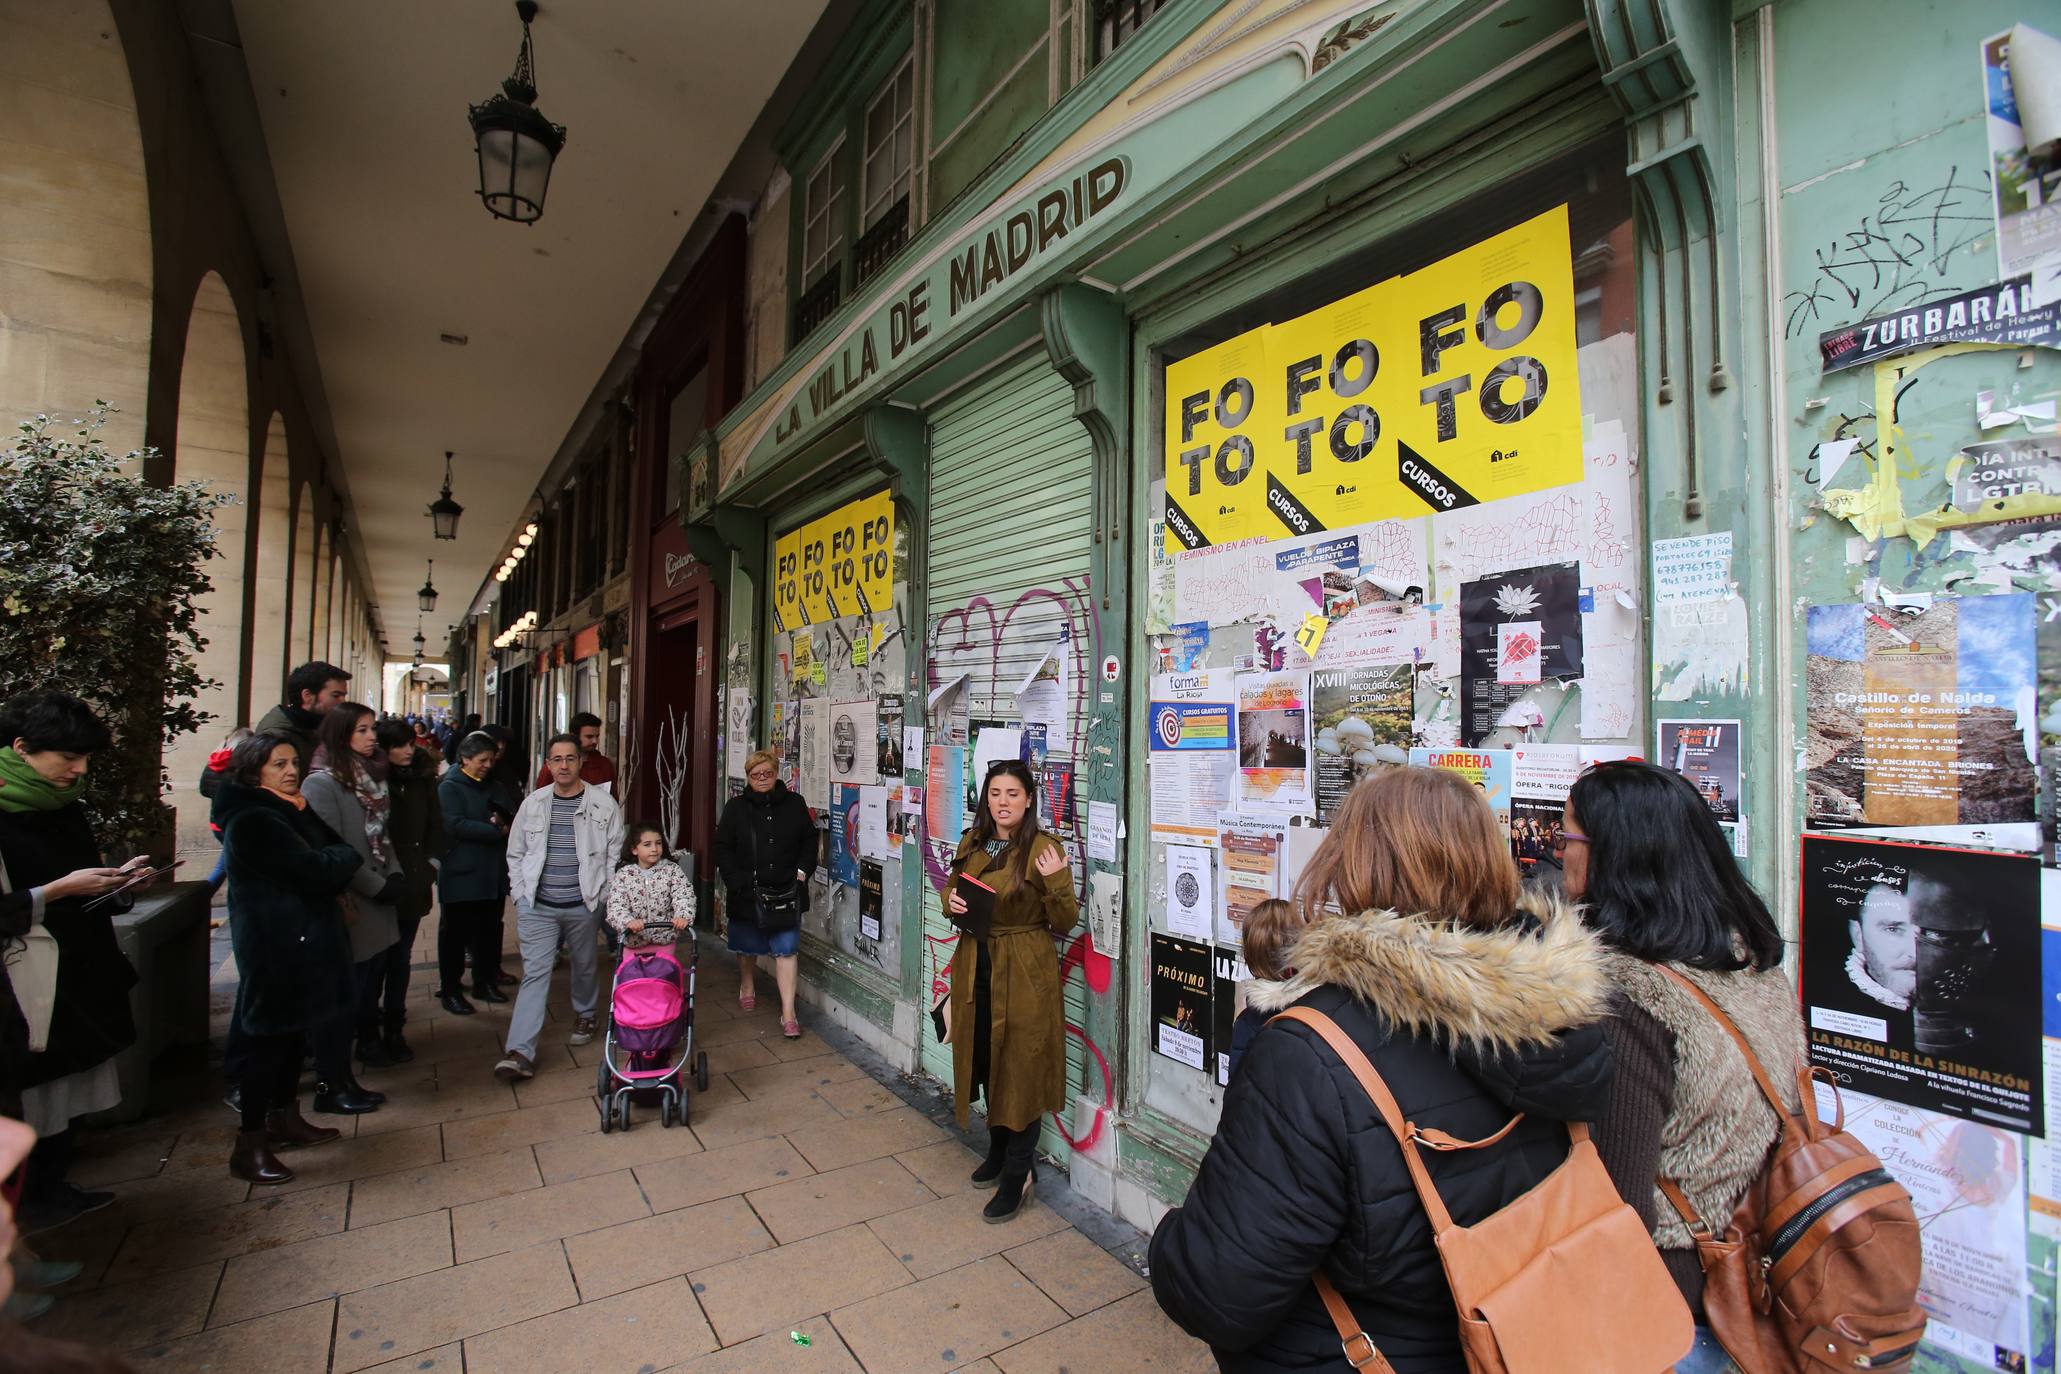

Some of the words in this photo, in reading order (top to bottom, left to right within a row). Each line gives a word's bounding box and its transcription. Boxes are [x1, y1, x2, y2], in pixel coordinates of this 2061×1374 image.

[776, 409, 801, 446] LA
[808, 330, 880, 416] VILLA
[889, 278, 932, 360] DE
[949, 154, 1133, 317] MADRID
[1420, 280, 1544, 377] FO
[1923, 326, 1979, 344] Festival
[1985, 320, 2002, 331] de
[2008, 311, 2053, 326] Heavy
[1829, 338, 1857, 358] LIBRE
[1286, 338, 1380, 416] FO
[1181, 376, 1254, 443] FO
[1420, 355, 1548, 443] TO
[1285, 403, 1381, 475] TO
[1180, 434, 1254, 496] TO
[1504, 450, 1518, 459] cdi
[1401, 460, 1457, 508] CURSOS
[1268, 487, 1310, 533] CURSOS
[863, 515, 889, 550] FO
[1166, 507, 1200, 547] CURSOS
[832, 526, 855, 559] FO
[1179, 544, 1224, 561] FEMINISMO
[1225, 541, 1238, 552] EN
[1316, 540, 1356, 554] BIPLAZA
[1671, 539, 1703, 549] VENDE
[1706, 536, 1730, 546] PISO
[779, 552, 797, 580] FO
[804, 540, 824, 570] FO
[862, 549, 888, 583] TO
[1288, 550, 1344, 567] PARAPENTE
[803, 569, 824, 598] TO
[831, 558, 855, 589] TO
[778, 579, 797, 606] TO
[1170, 676, 1199, 689] forma
[1315, 672, 1347, 688] XVIII
[1350, 669, 1389, 680] JORNADAS
[1350, 680, 1400, 691] MICOLÓGICAS
[1186, 691, 1203, 699] Rioja
[1268, 690, 1274, 699] y
[1275, 688, 1304, 698] lagares
[1350, 695, 1360, 703] DE
[1361, 692, 1387, 702] OTOÑO
[1834, 692, 1900, 704] Castillo
[1908, 692, 1931, 704] de
[1940, 692, 1996, 704] Nalda
[1201, 707, 1227, 715] GRATUITOS
[1900, 706, 1915, 714] de
[1919, 706, 1971, 715] Cameros
[1917, 722, 1957, 730] temporal
[1897, 736, 1927, 744] octubre
[1428, 753, 1492, 769] CARRERA
[1852, 757, 1879, 765] CASA
[1948, 761, 1994, 770] BRIONES
[1889, 766, 1918, 774] Marqués
[1220, 819, 1238, 827] Música
[1239, 820, 1285, 830] Contemporánea
[1157, 964, 1205, 988] PRÓXIMO
[1216, 956, 1230, 980] LA
[1811, 1053, 1830, 1062] Lector
[1833, 1057, 1860, 1070] dirección
[1860, 1064, 1886, 1077] Cipriano
[1812, 1031, 1830, 1043] LA
[1833, 1035, 1885, 1057] RAZÓN
[1889, 1048, 1910, 1063] DE
[1914, 1054, 1935, 1068] LA
[1938, 1059, 2030, 1092] SINRAZÓN
[1812, 1044, 1842, 1056] LECTURA
[1842, 1050, 1895, 1069] DRAMATIZADA
[1895, 1061, 1927, 1076] BASADA
[1938, 1073, 1968, 1086] TEXTOS
[1969, 1081, 1981, 1089] DE
[1981, 1084, 1992, 1092] EL
[1992, 1086, 2030, 1102] QUIJOTE
[1933, 1081, 1940, 1089] la
[1966, 1088, 1998, 1104] Francisco
[1998, 1098, 2030, 1113] Sagredo
[1874, 1119, 1921, 1139] COLECCIÓN
